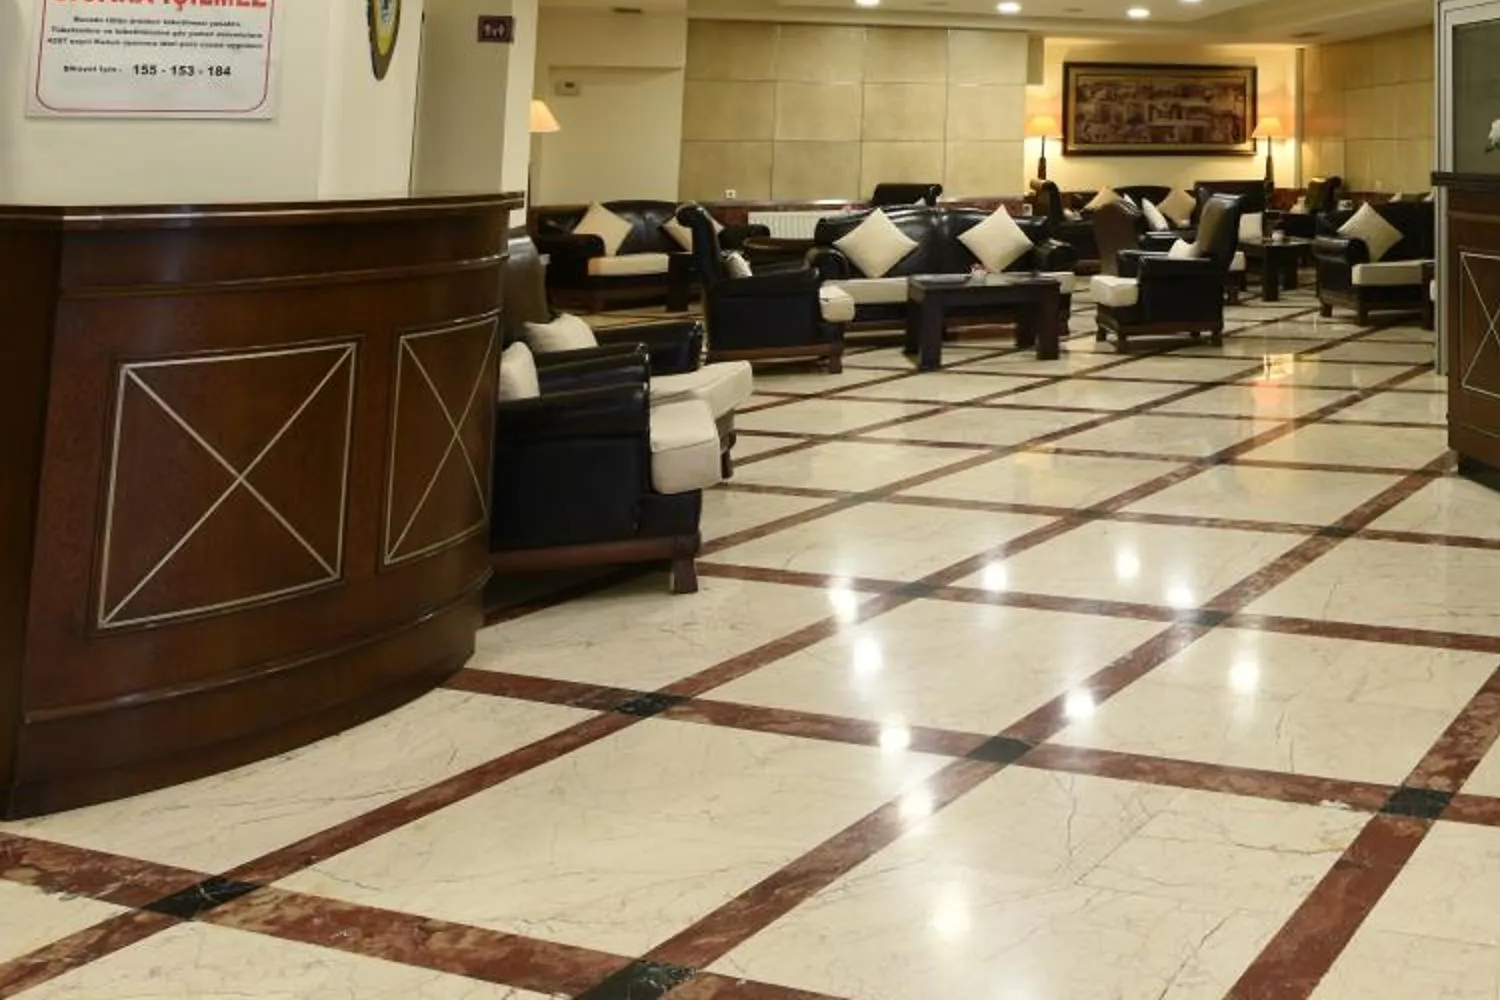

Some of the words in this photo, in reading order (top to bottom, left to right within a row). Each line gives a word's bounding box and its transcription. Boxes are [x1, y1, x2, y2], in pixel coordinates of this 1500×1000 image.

[133, 64, 157, 76] 155
[171, 65, 195, 77] 153
[207, 66, 232, 77] 184
